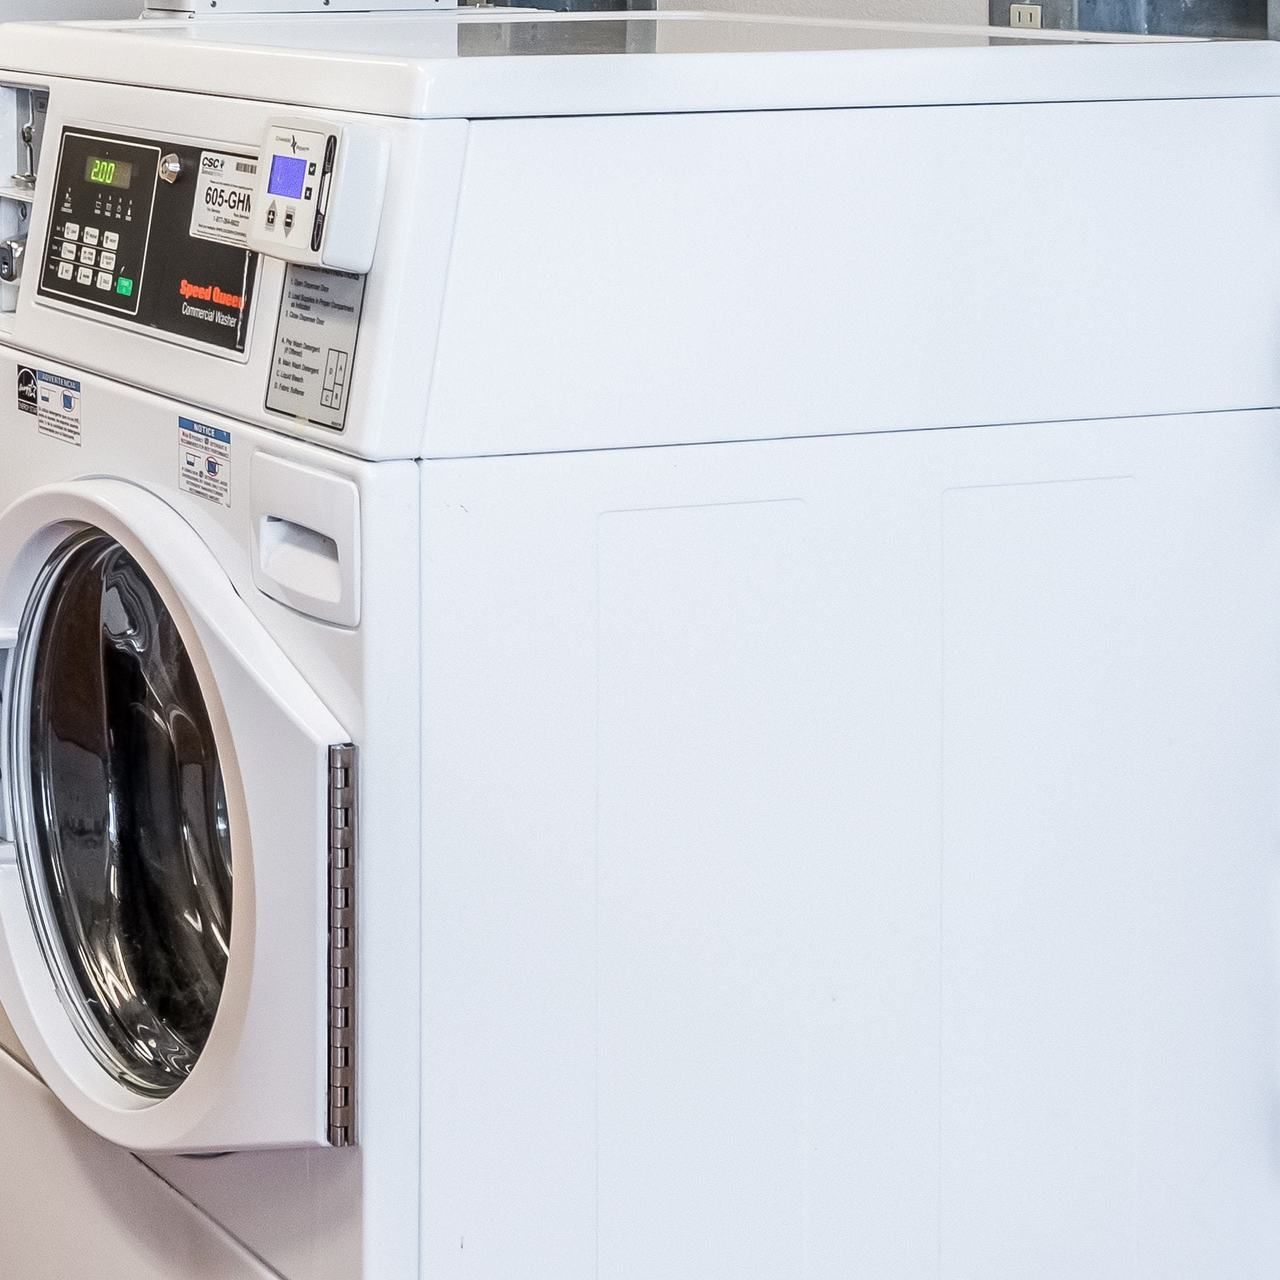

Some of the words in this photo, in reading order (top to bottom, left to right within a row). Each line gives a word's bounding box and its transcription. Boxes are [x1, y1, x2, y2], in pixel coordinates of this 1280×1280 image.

[202, 157, 219, 169] CSC
[180, 279, 212, 299] Speed
[213, 287, 244, 309] Queen
[182, 302, 215, 321] Commercial
[216, 310, 237, 327] Washer
[193, 422, 215, 437] NOTICE
